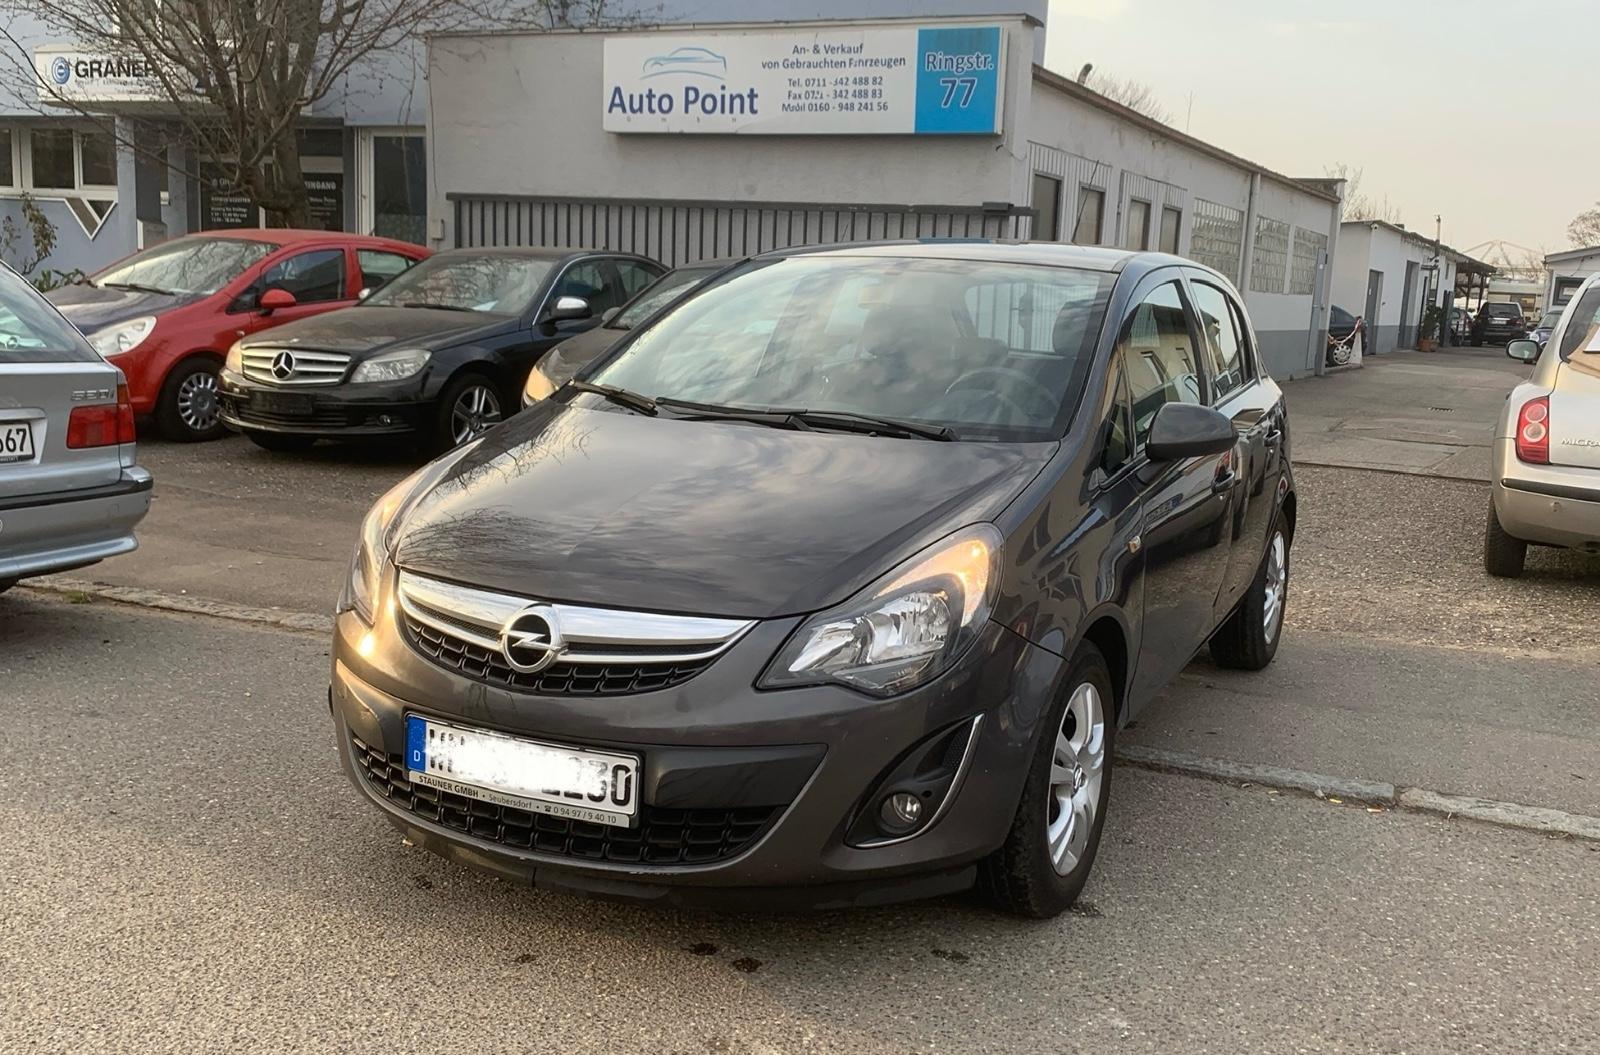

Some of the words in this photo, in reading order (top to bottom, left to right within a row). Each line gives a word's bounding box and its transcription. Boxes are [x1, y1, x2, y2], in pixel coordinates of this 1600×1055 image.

[792, 44, 810, 55] An-
[812, 44, 821, 55] &
[823, 43, 864, 55] Verkauf
[761, 60, 780, 70] von
[782, 58, 847, 70] Gebrauchten
[925, 51, 994, 75] Ringstr.
[804, 77, 827, 88] 0711
[852, 76, 869, 86] 488
[871, 76, 883, 86] 82
[787, 90, 802, 100] Fax
[832, 89, 849, 99] 342
[851, 89, 869, 99] 488
[871, 88, 883, 98] 83
[940, 77, 977, 108] 77
[607, 86, 674, 114] Auto
[684, 84, 759, 115] Point
[807, 102, 830, 112] 0160
[838, 102, 855, 112] 948
[857, 102, 874, 111] 241
[876, 101, 889, 111] 56
[0, 427, 27, 453] 67
[413, 750, 421, 762] D
[418, 775, 453, 792] STAUNER
[454, 785, 479, 799] GMBH
[488, 793, 532, 810] Seubersdorf
[553, 806, 559, 814] 0
[560, 807, 570, 816] 94
[572, 809, 582, 818] 97
[587, 812, 593, 820] 9
[594, 813, 605, 822] 40
[606, 815, 617, 824] 10
